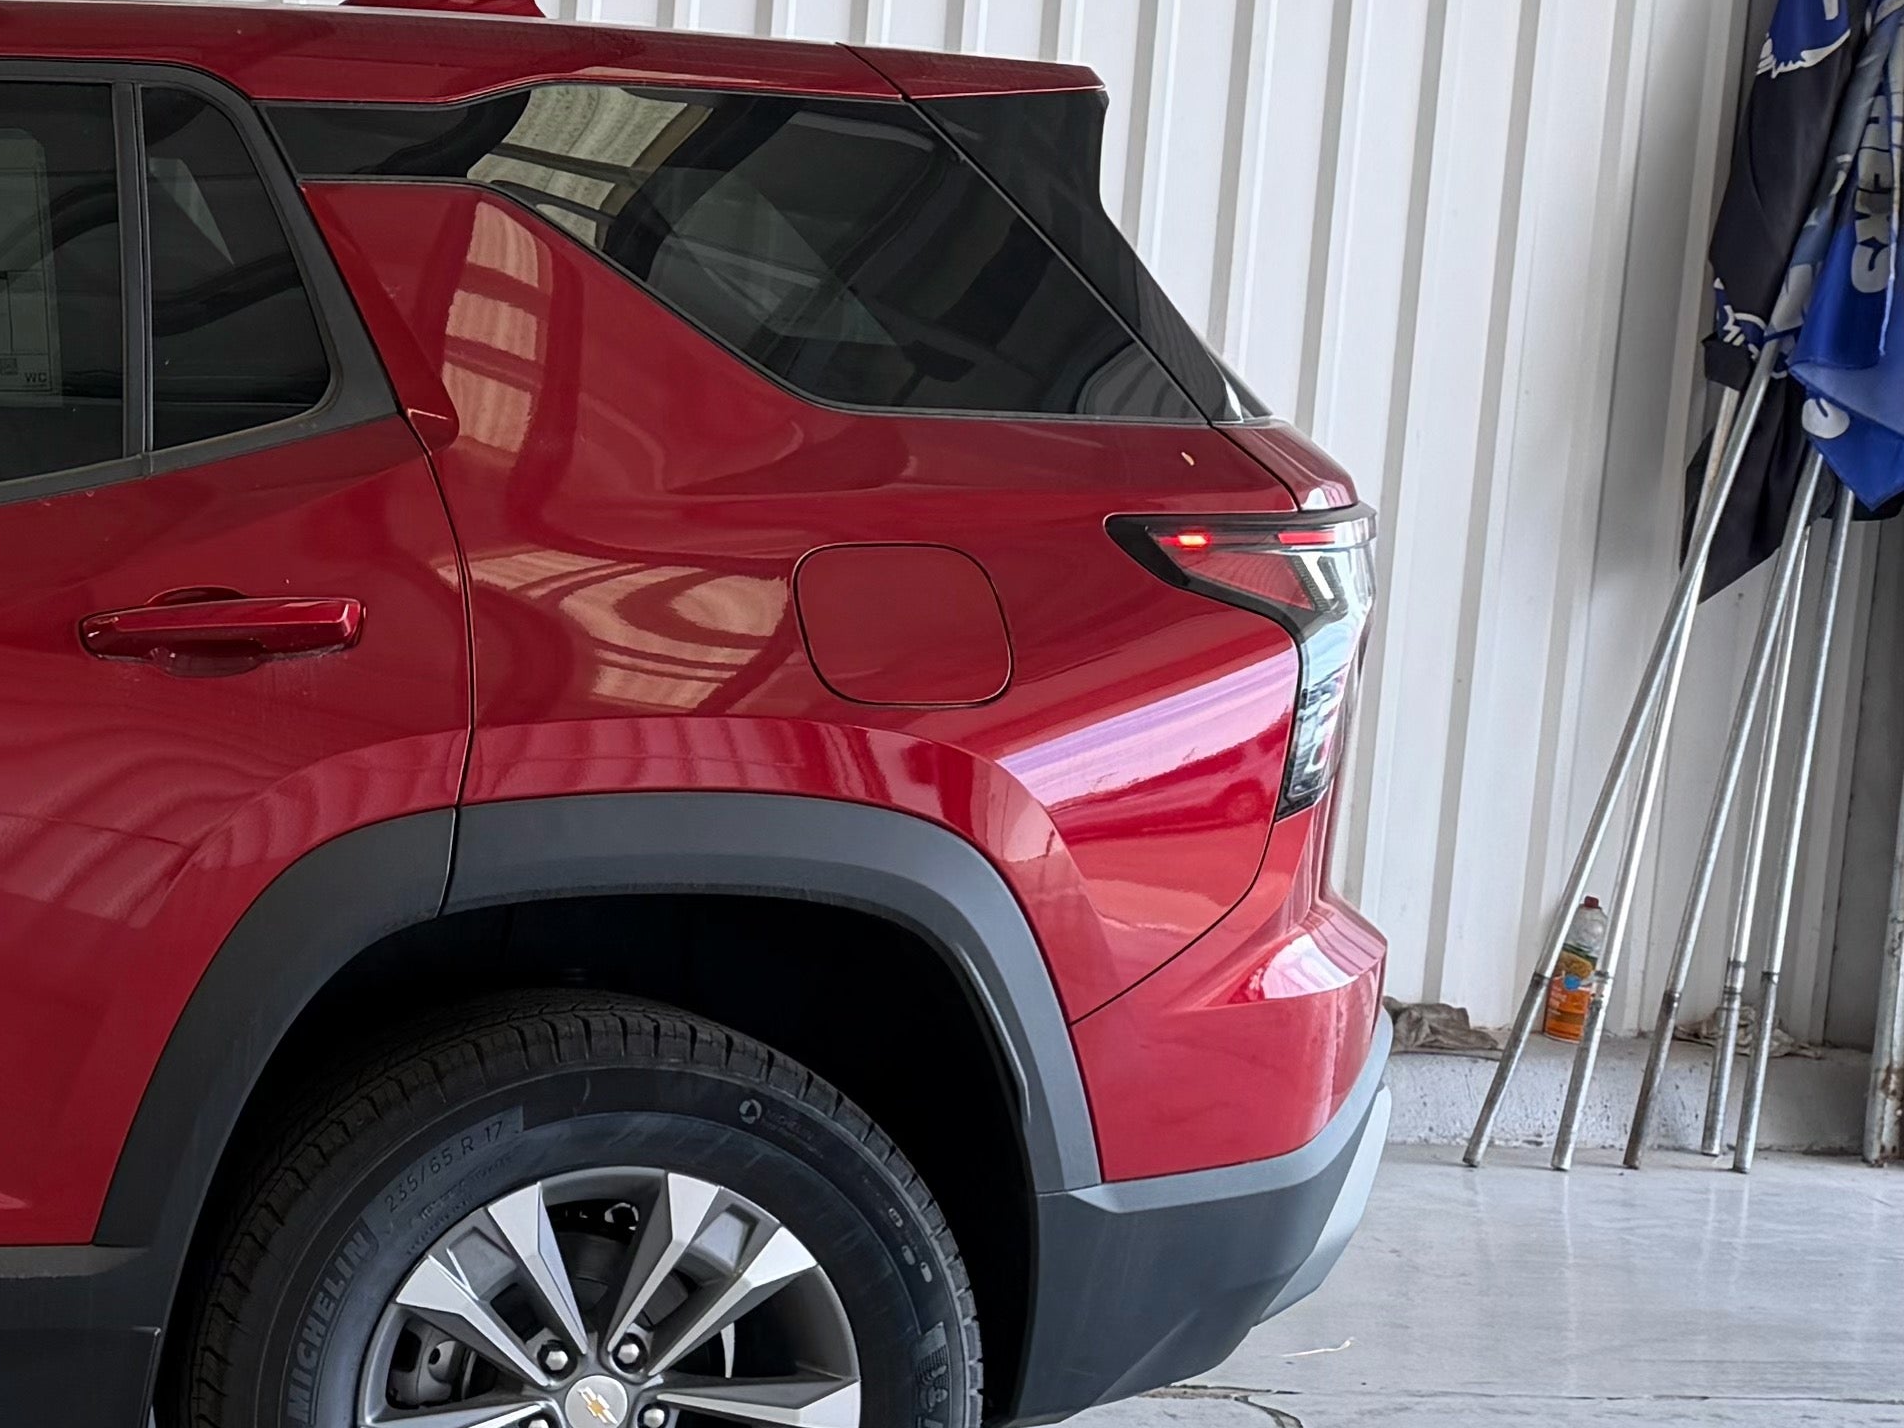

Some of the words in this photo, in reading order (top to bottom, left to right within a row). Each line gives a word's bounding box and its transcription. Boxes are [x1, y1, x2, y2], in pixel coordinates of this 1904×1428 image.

[384, 1149, 454, 1214] 235/65
[461, 1135, 476, 1157] R
[484, 1119, 505, 1144] 17
[287, 1229, 374, 1423] MICHELIN
